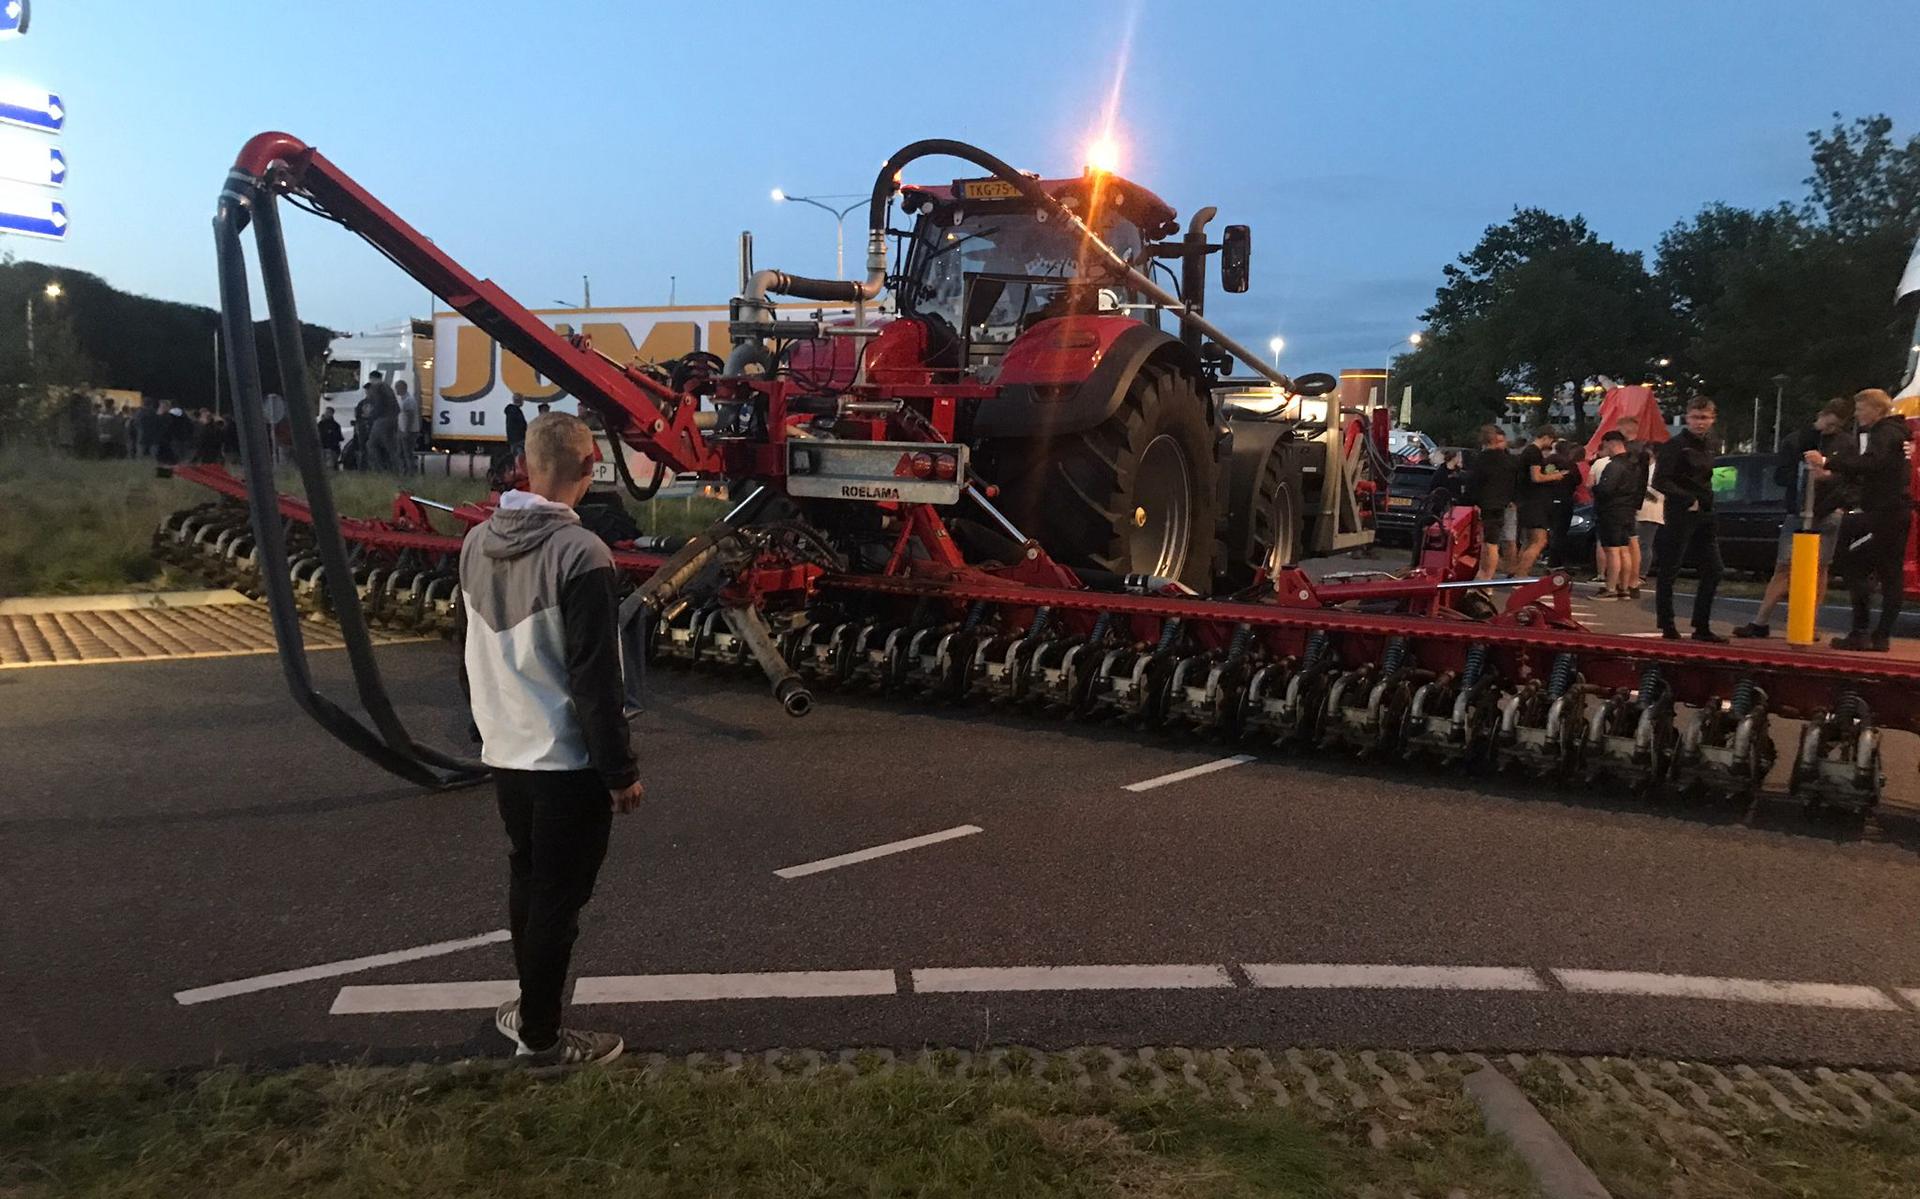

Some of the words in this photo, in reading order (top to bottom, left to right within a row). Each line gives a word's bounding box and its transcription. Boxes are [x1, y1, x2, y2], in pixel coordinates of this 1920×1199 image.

[968, 183, 1017, 197] TKG-75-
[438, 320, 730, 403] JUM
[841, 485, 900, 499] ROELAMA
